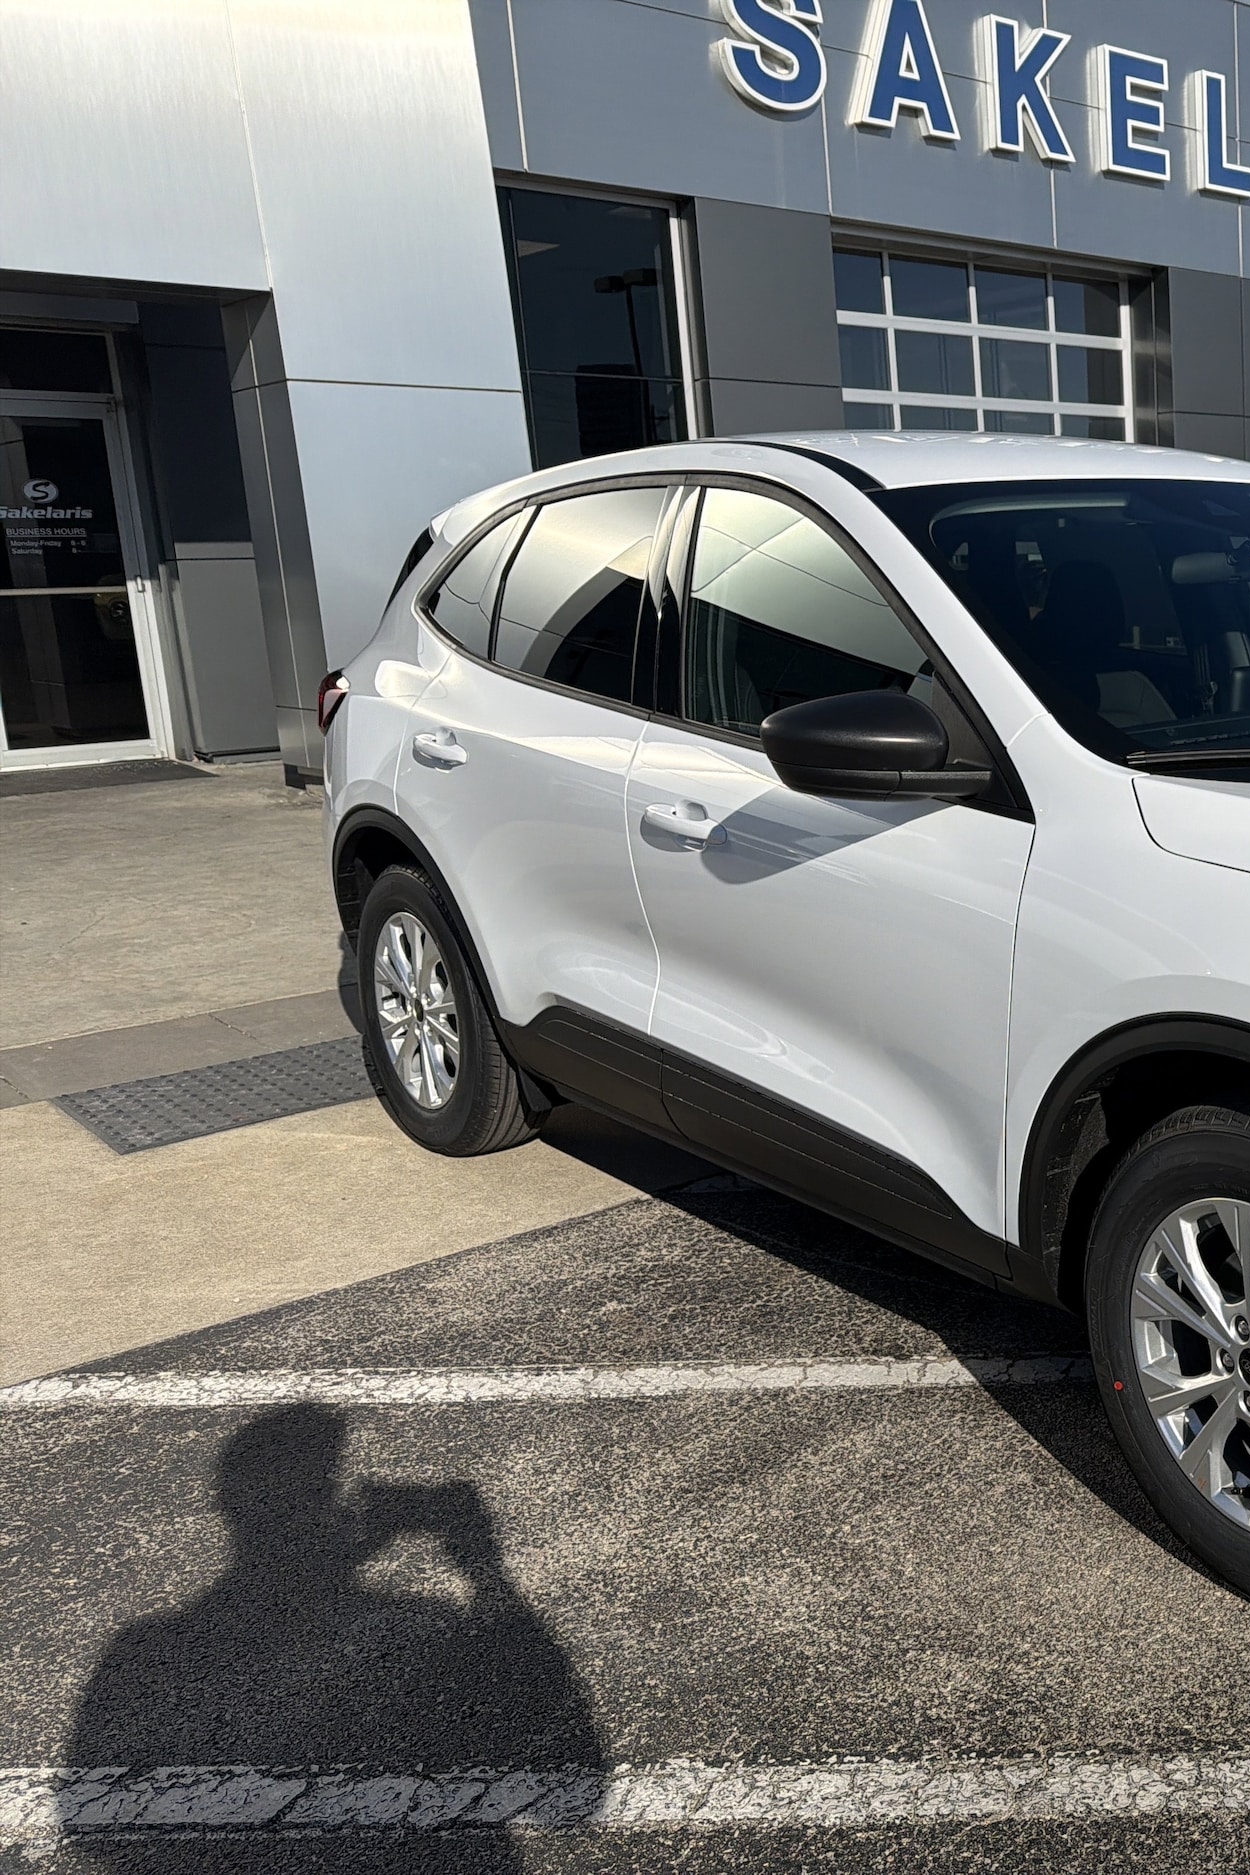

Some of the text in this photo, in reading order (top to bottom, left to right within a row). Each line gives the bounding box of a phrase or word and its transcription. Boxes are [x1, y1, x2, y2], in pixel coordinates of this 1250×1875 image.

[0, 506, 93, 519] Sakelaris
[6, 527, 86, 536] BUSINESS HOURS
